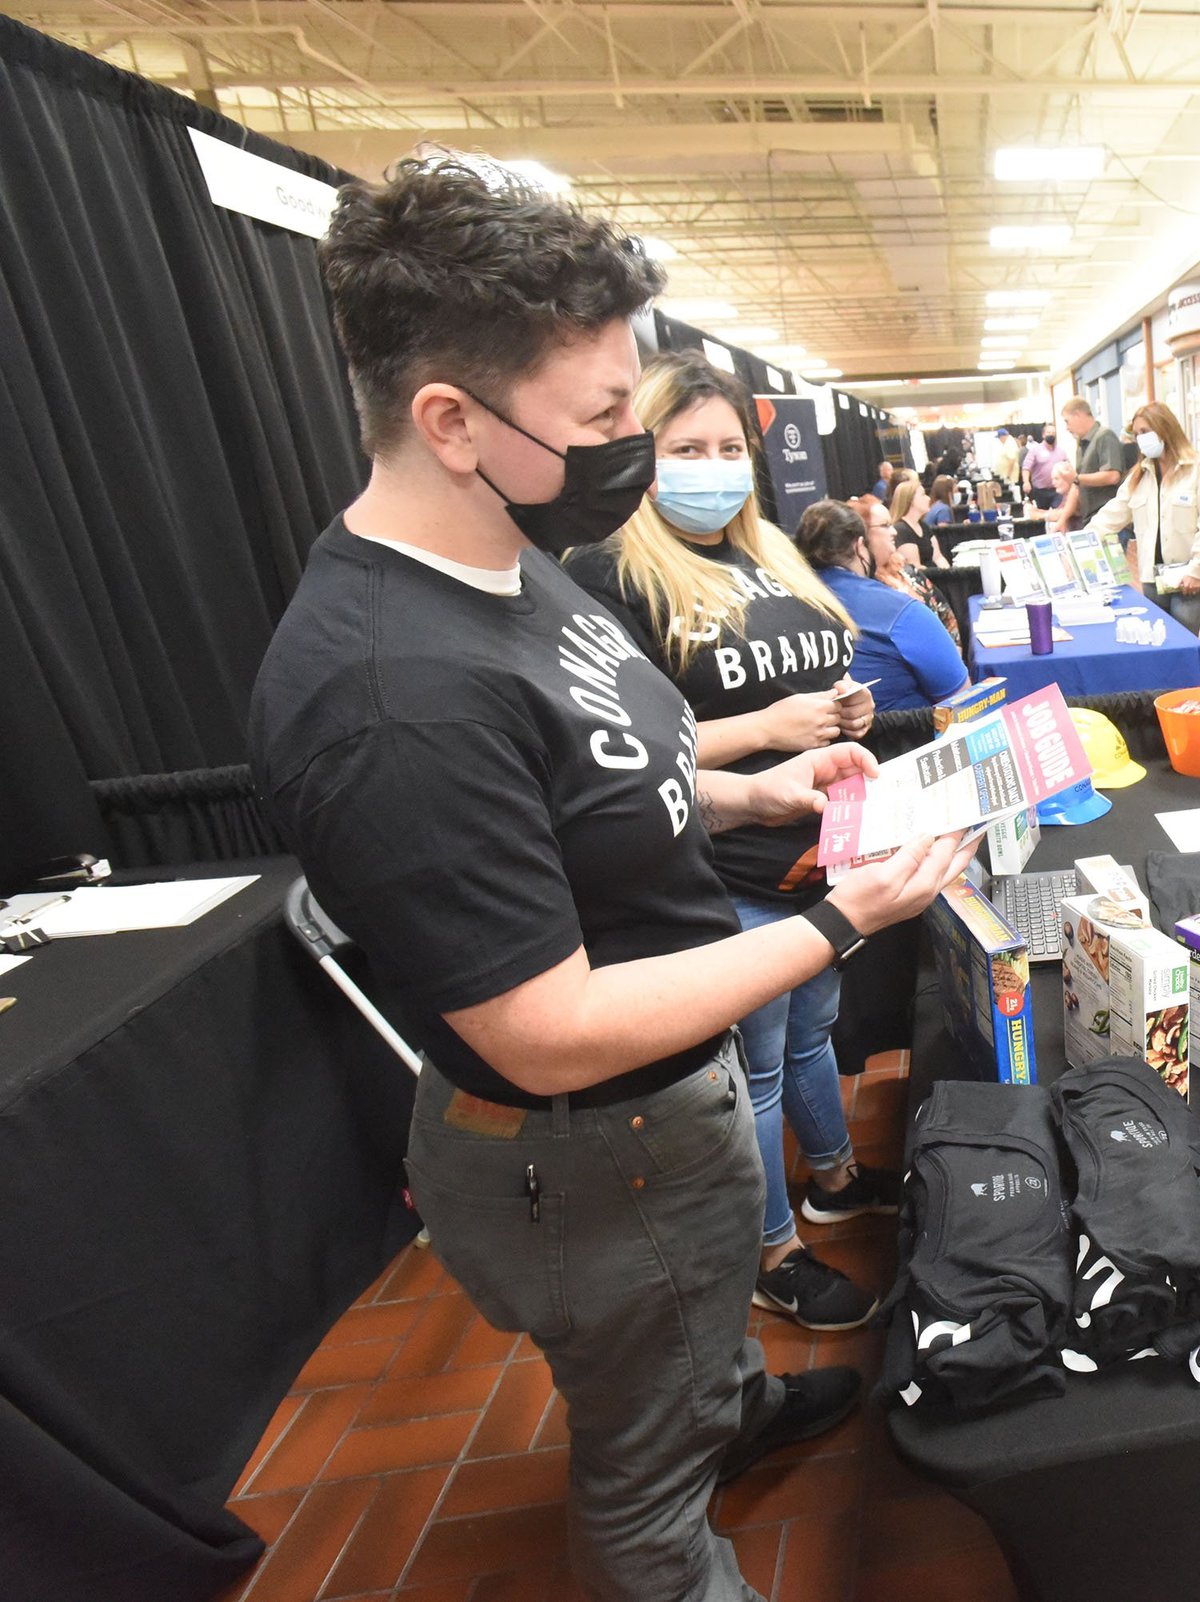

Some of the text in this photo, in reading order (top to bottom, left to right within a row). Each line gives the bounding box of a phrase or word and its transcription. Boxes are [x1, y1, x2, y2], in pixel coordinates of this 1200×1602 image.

[714, 629, 855, 690] BRANDS
[558, 614, 651, 770] CONAGR
[1022, 700, 1057, 740] JOB
[1034, 732, 1076, 790] GUIDE
[1122, 1120, 1153, 1149] SPORTIQE
